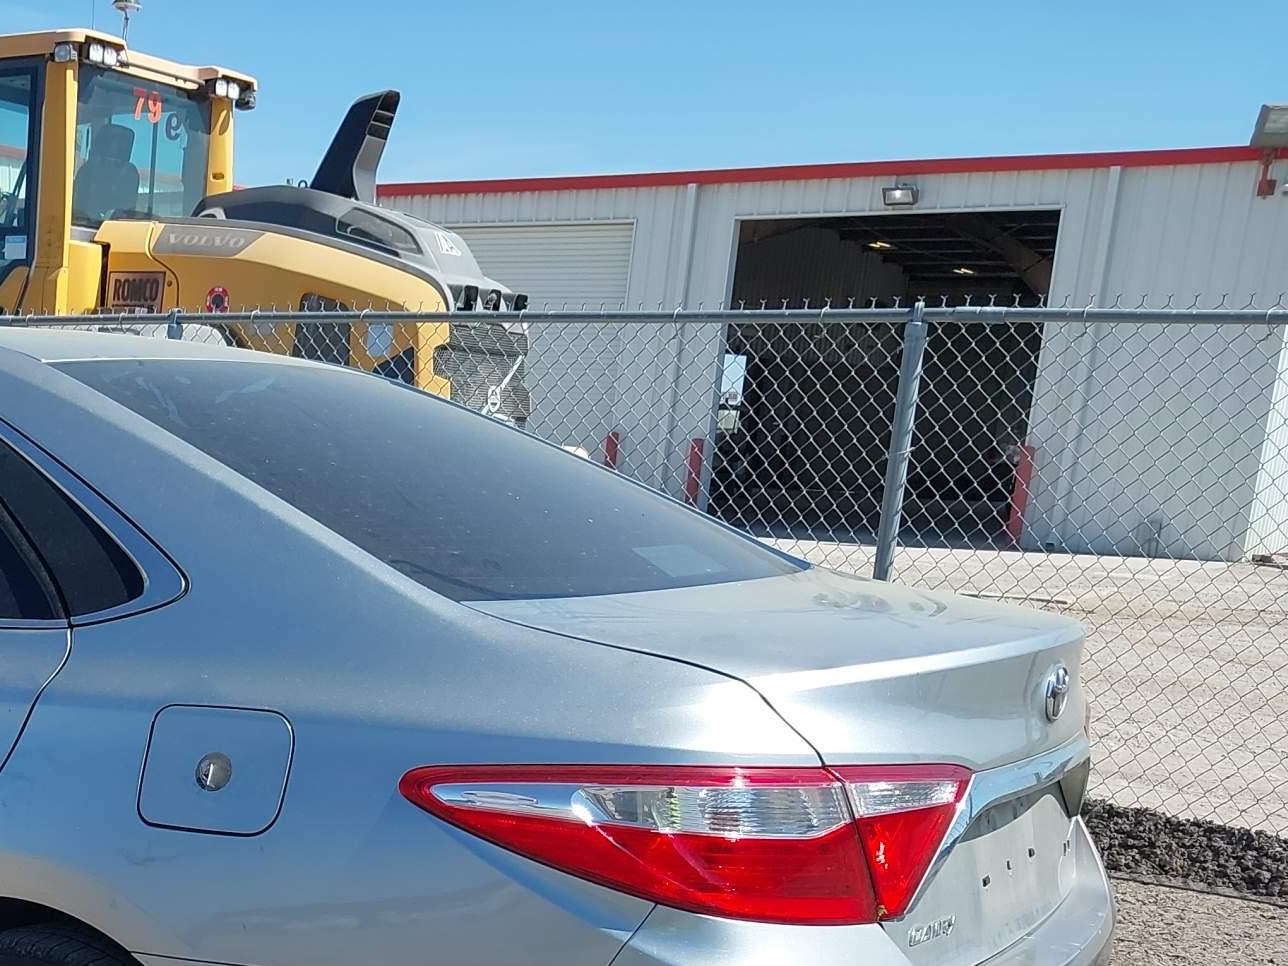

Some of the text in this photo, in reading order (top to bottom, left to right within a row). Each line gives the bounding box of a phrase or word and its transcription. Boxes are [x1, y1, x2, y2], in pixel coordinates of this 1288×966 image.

[133, 87, 162, 124] 79
[167, 232, 245, 249] VOLVO
[112, 277, 160, 303] ROMCO
